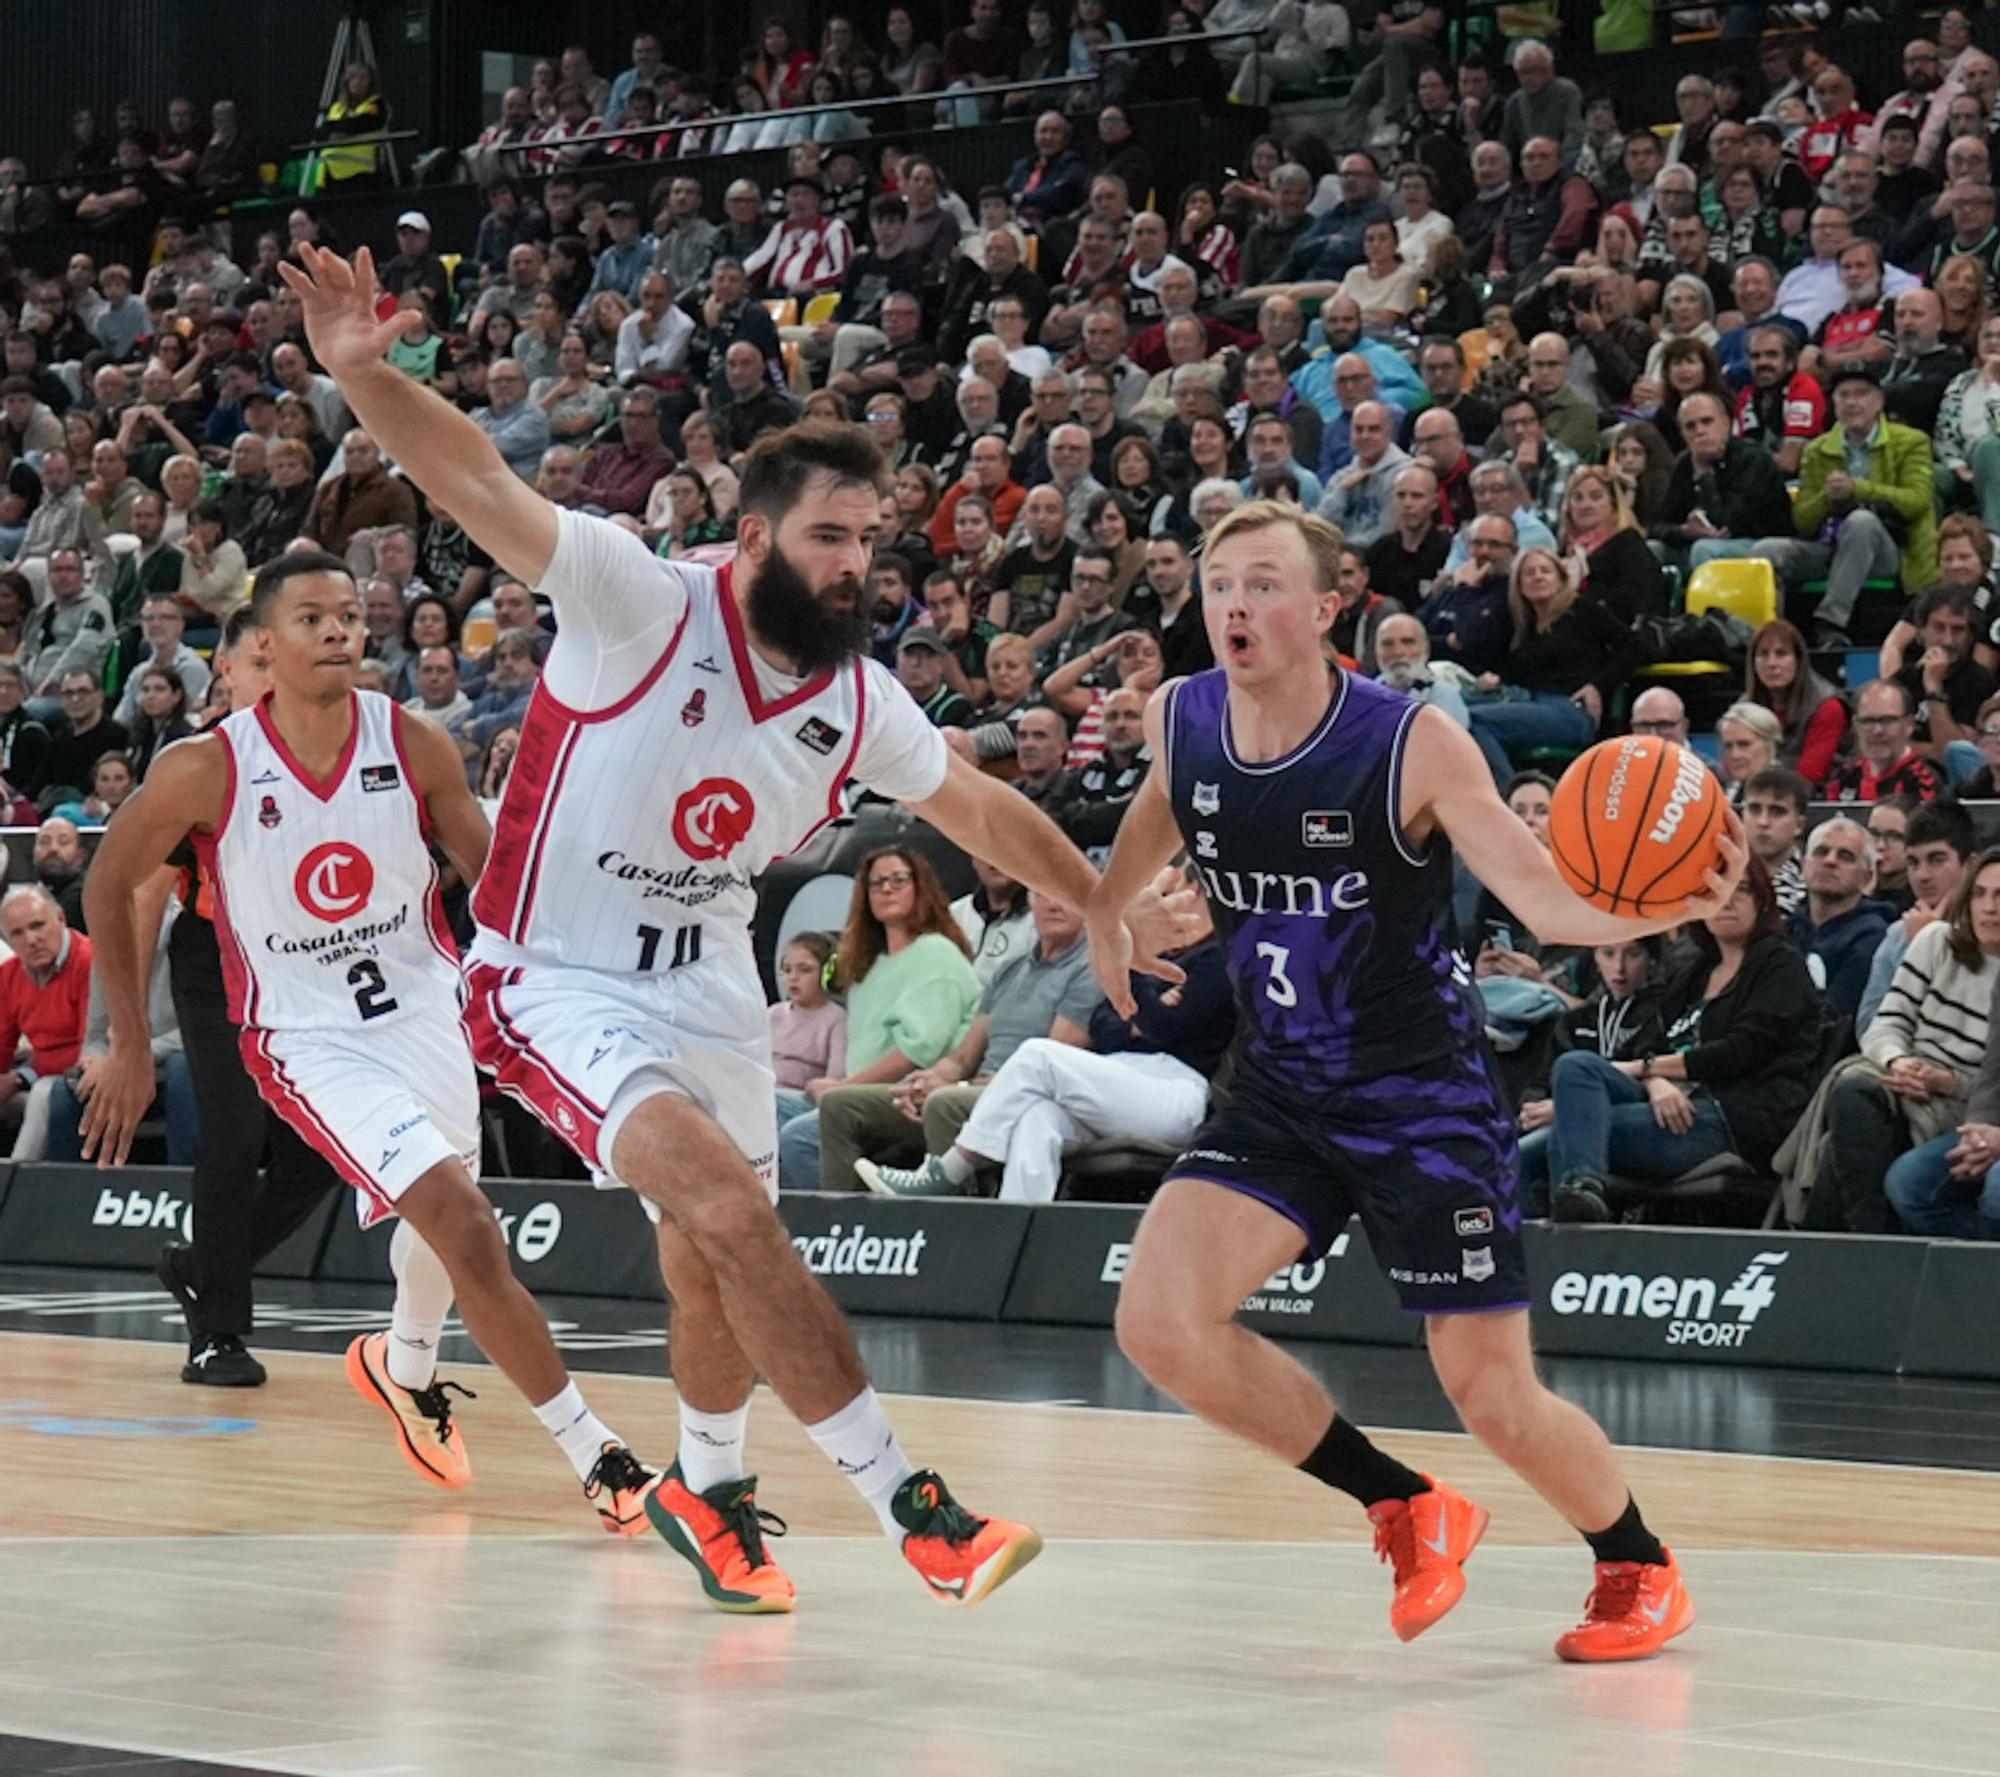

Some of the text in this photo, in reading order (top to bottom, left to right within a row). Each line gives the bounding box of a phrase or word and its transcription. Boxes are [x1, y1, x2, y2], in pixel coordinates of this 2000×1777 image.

[1202, 866, 1370, 917] urne
[347, 958, 399, 1021] 2
[1256, 940, 1297, 1008] 3
[91, 1188, 183, 1229] bbk
[1269, 1297, 1314, 1314] VALOR
[1665, 1320, 1753, 1347] SPORT
